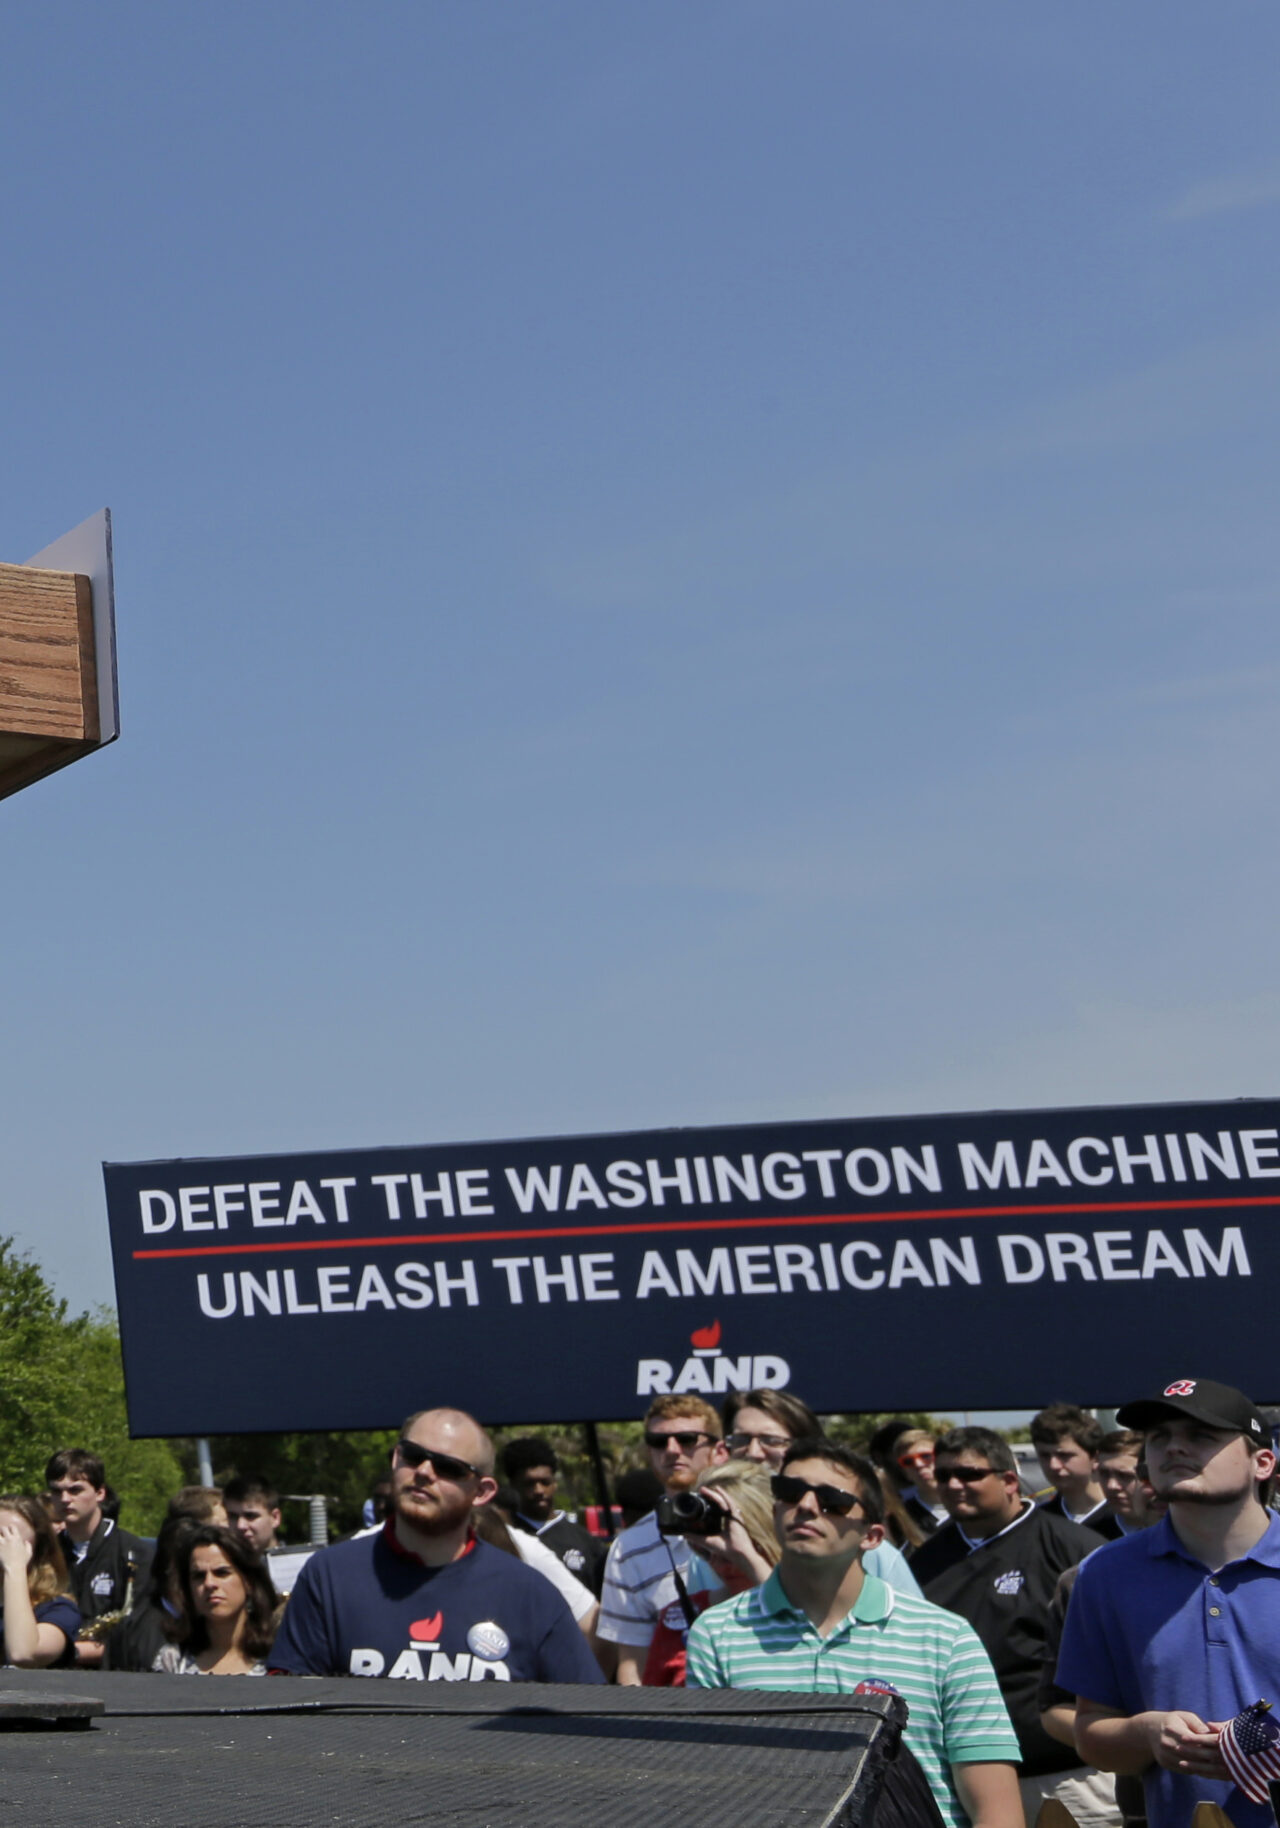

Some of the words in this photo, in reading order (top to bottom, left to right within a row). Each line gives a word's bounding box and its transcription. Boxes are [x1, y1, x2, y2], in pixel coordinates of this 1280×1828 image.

[138, 1177, 357, 1234] DEFEAT
[371, 1169, 495, 1220] THE
[504, 1144, 942, 1213] WASHINGTON
[957, 1128, 1280, 1191] MACHINE
[196, 1259, 480, 1319] UNLEASH
[492, 1252, 620, 1304] THE
[636, 1236, 981, 1299] AMERICAN
[997, 1226, 1252, 1284] DREAM
[636, 1355, 791, 1396] RAND
[349, 1648, 510, 1682] RAND
